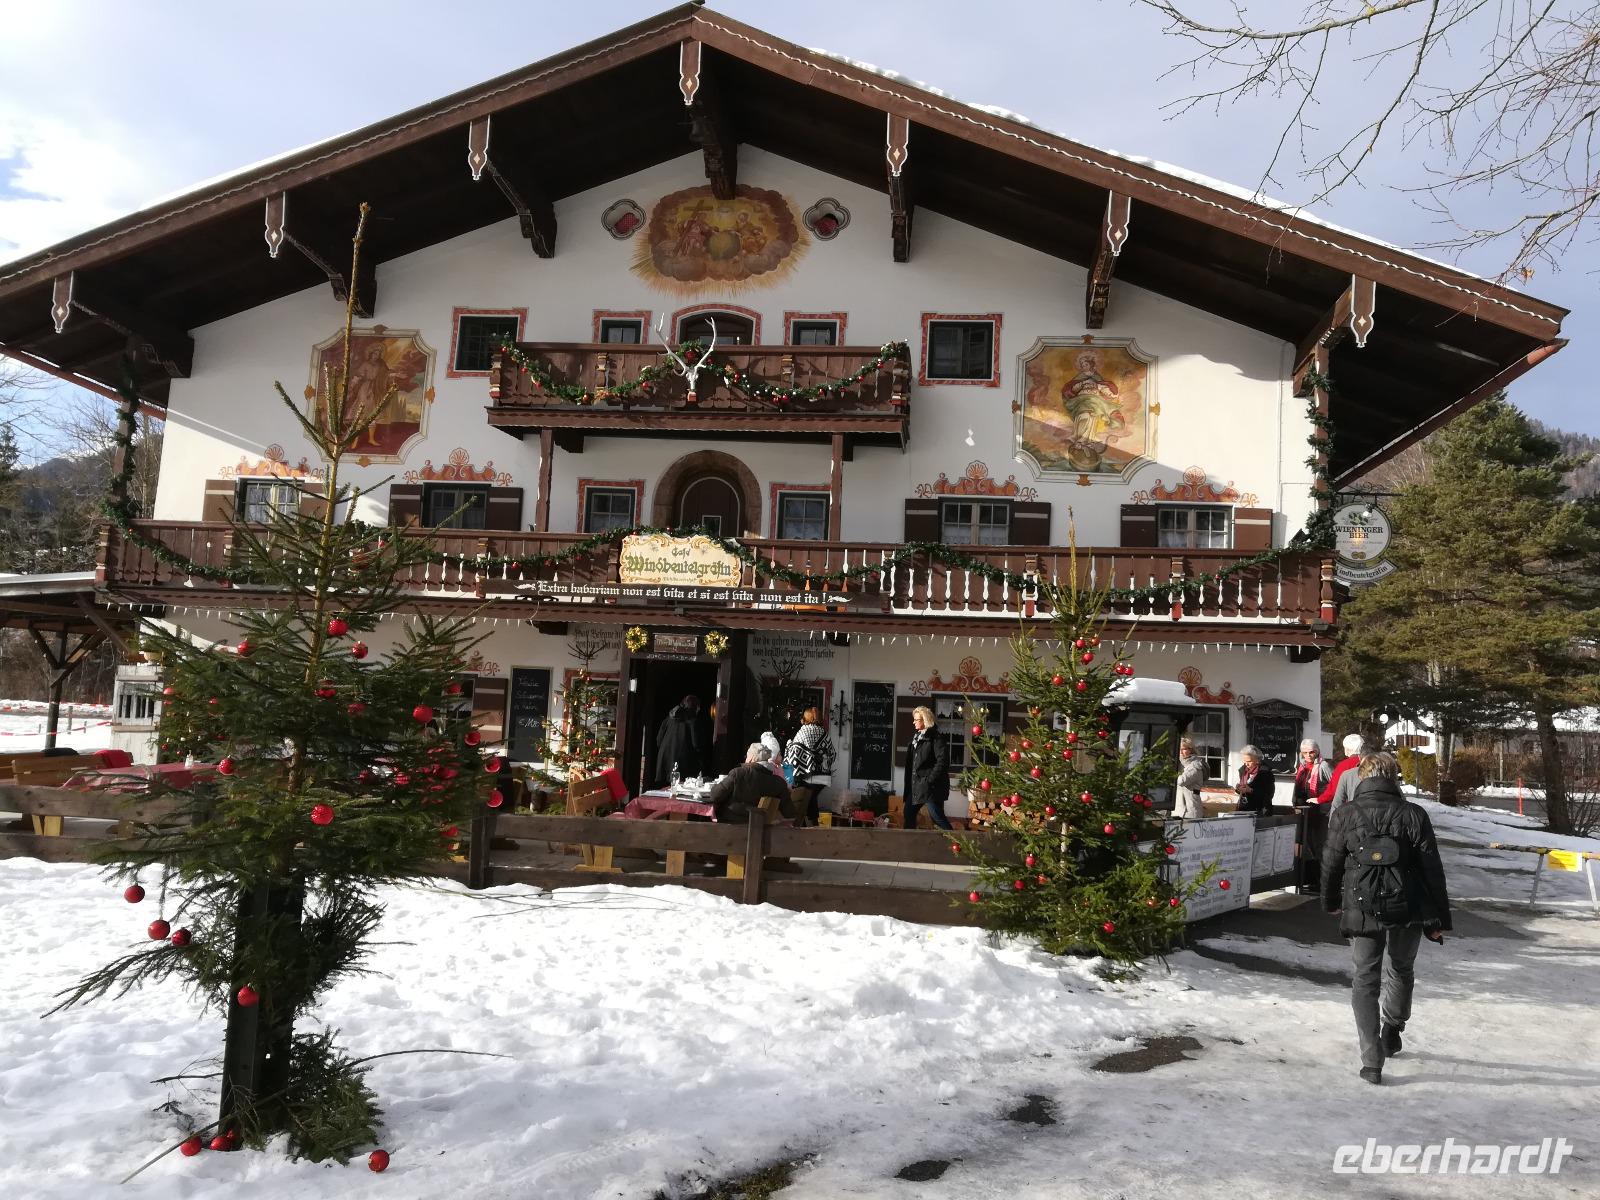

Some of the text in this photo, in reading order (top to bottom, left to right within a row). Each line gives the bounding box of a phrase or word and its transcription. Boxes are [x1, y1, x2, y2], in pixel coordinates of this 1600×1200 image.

[537, 580, 568, 595] Extra
[623, 587, 643, 597] non
[645, 586, 662, 597] est
[687, 588, 698, 599] et
[700, 589, 711, 600] si
[713, 589, 730, 600] est
[760, 593, 782, 602] non
[785, 592, 802, 603] est
[804, 592, 819, 604] ita
